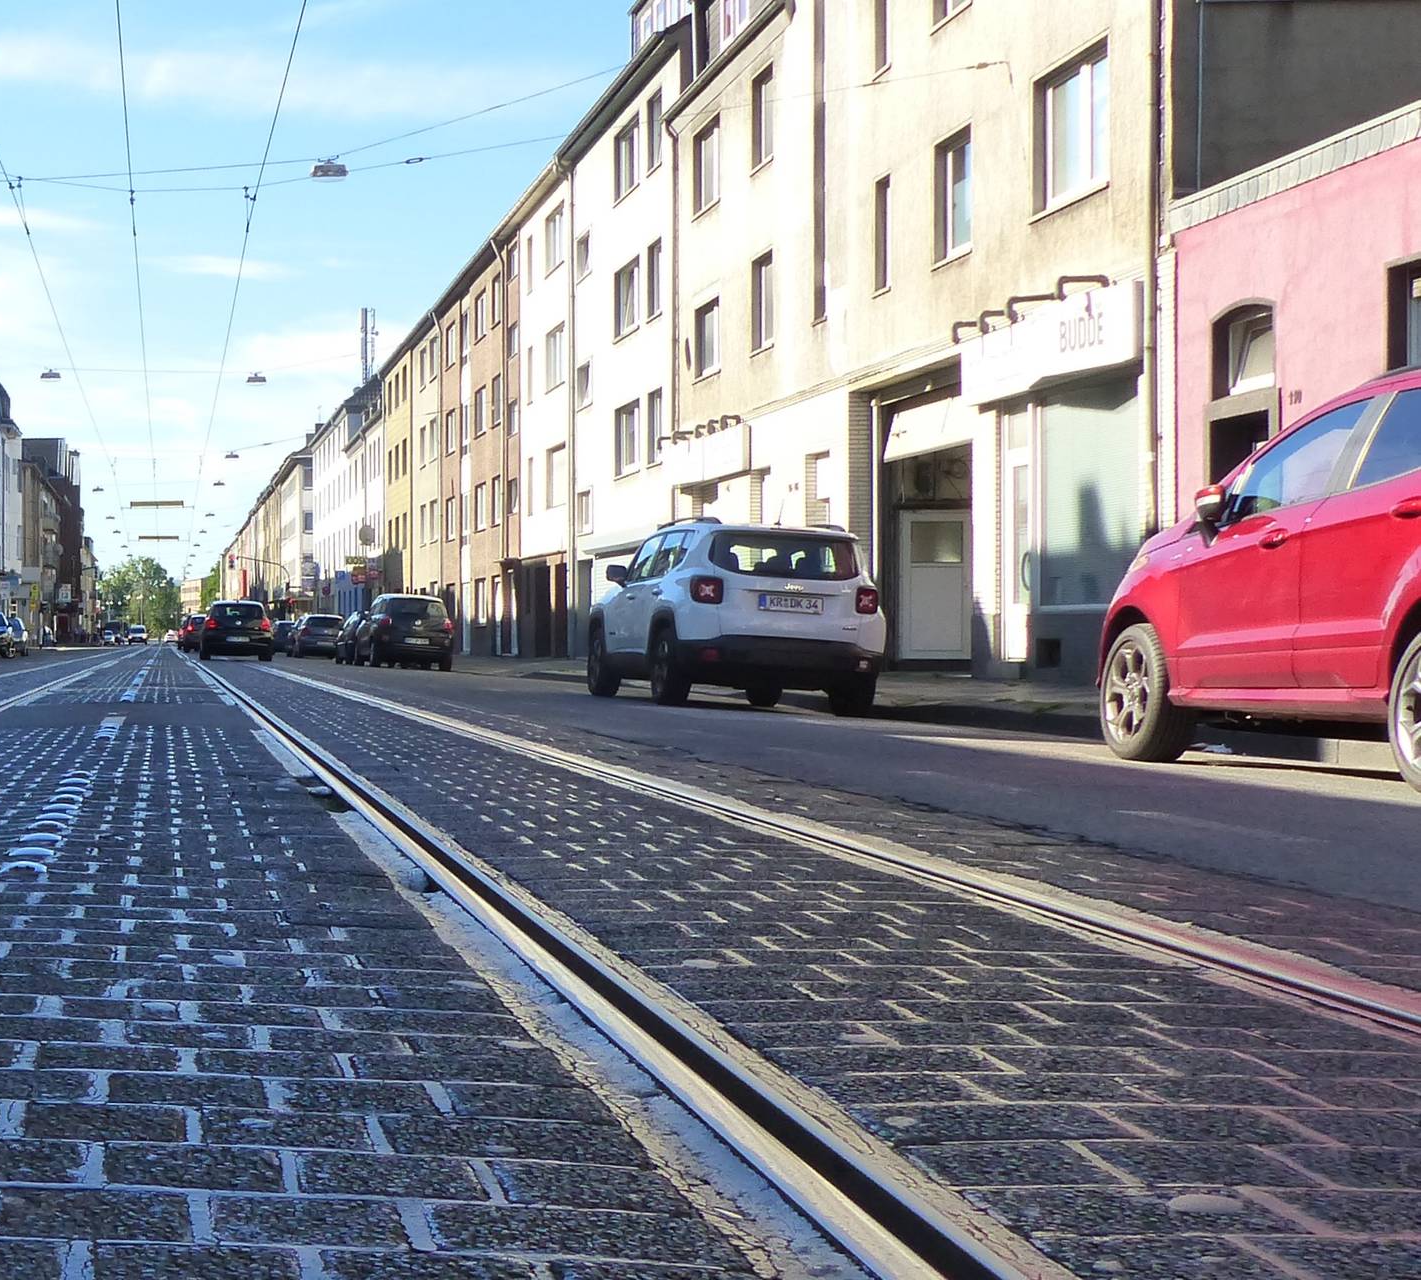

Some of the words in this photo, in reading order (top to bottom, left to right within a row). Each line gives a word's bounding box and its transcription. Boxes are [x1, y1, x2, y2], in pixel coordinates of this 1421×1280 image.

[1059, 312, 1104, 353] BUDDE
[784, 583, 804, 591] Jeep
[770, 596, 782, 607] KR
[790, 599, 803, 608] DK
[805, 600, 818, 609] 34
